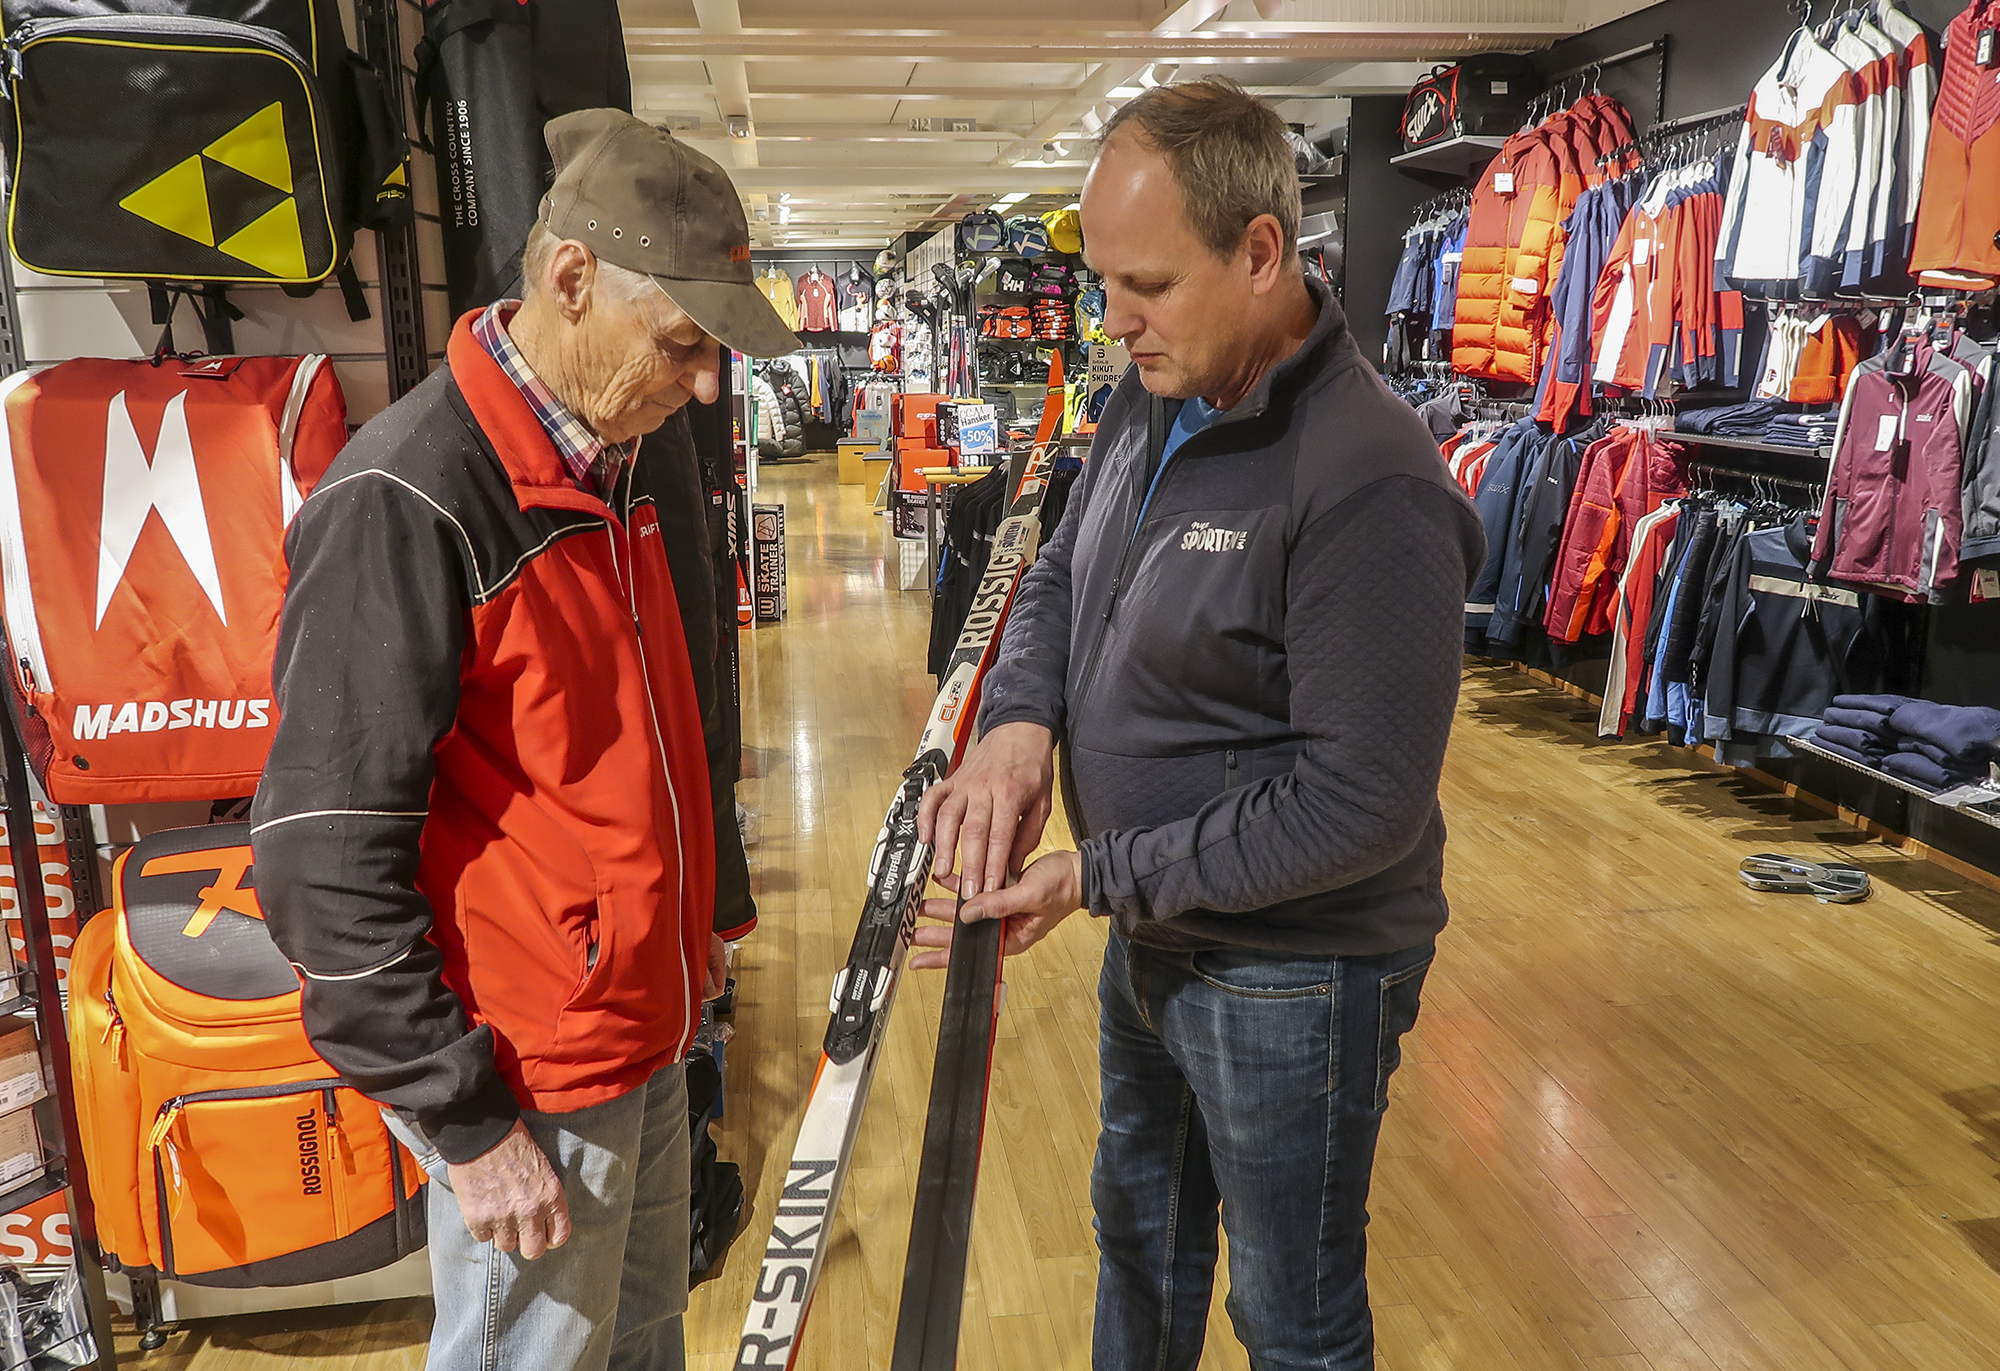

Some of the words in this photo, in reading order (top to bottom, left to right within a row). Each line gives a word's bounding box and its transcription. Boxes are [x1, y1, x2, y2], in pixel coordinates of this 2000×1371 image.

[445, 101, 457, 159] COUNTRY
[457, 99, 469, 129] 1906
[460, 131, 473, 165] SINCE
[450, 162, 462, 201] CROSS
[464, 168, 478, 226] COMPANY
[455, 204, 464, 227] THE
[1092, 365, 1114, 373] KIKUT
[961, 413, 990, 426] Hansker
[963, 430, 991, 442] -50%
[760, 543, 769, 592] SKATE
[769, 543, 779, 593] TRAINER
[72, 698, 271, 740] MADSHUS
[296, 1108, 322, 1195] ROSSIGNOL
[733, 1160, 838, 1371] R-SKIN
